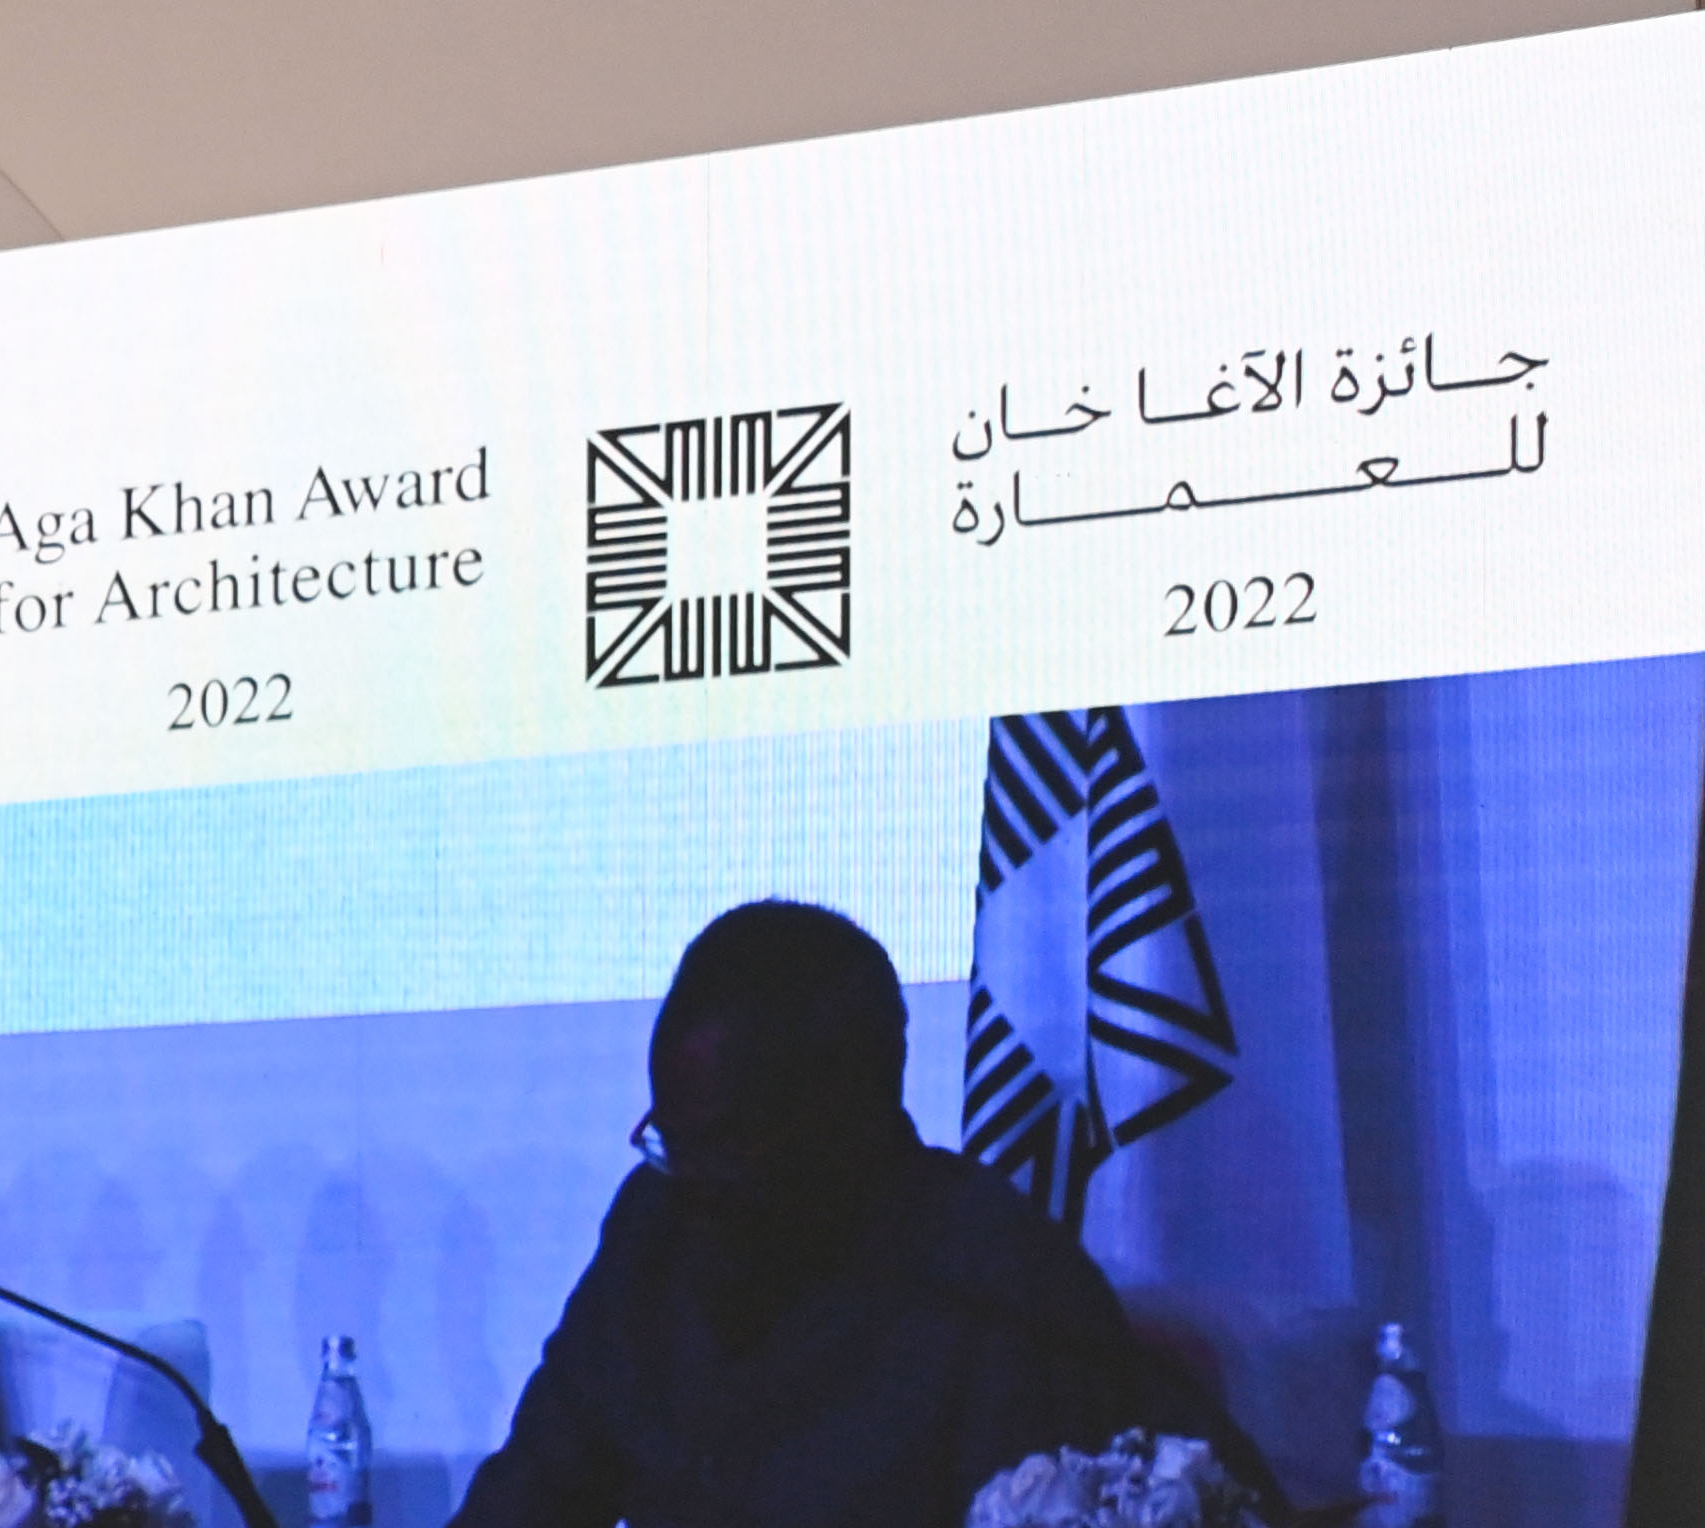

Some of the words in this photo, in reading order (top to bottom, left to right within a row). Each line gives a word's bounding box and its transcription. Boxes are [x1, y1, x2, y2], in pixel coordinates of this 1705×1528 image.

[121, 480, 275, 539] Khan
[297, 445, 489, 520] Award
[93, 553, 483, 624] Architecture
[1165, 570, 1317, 637] 2022
[168, 672, 293, 731] 2022
